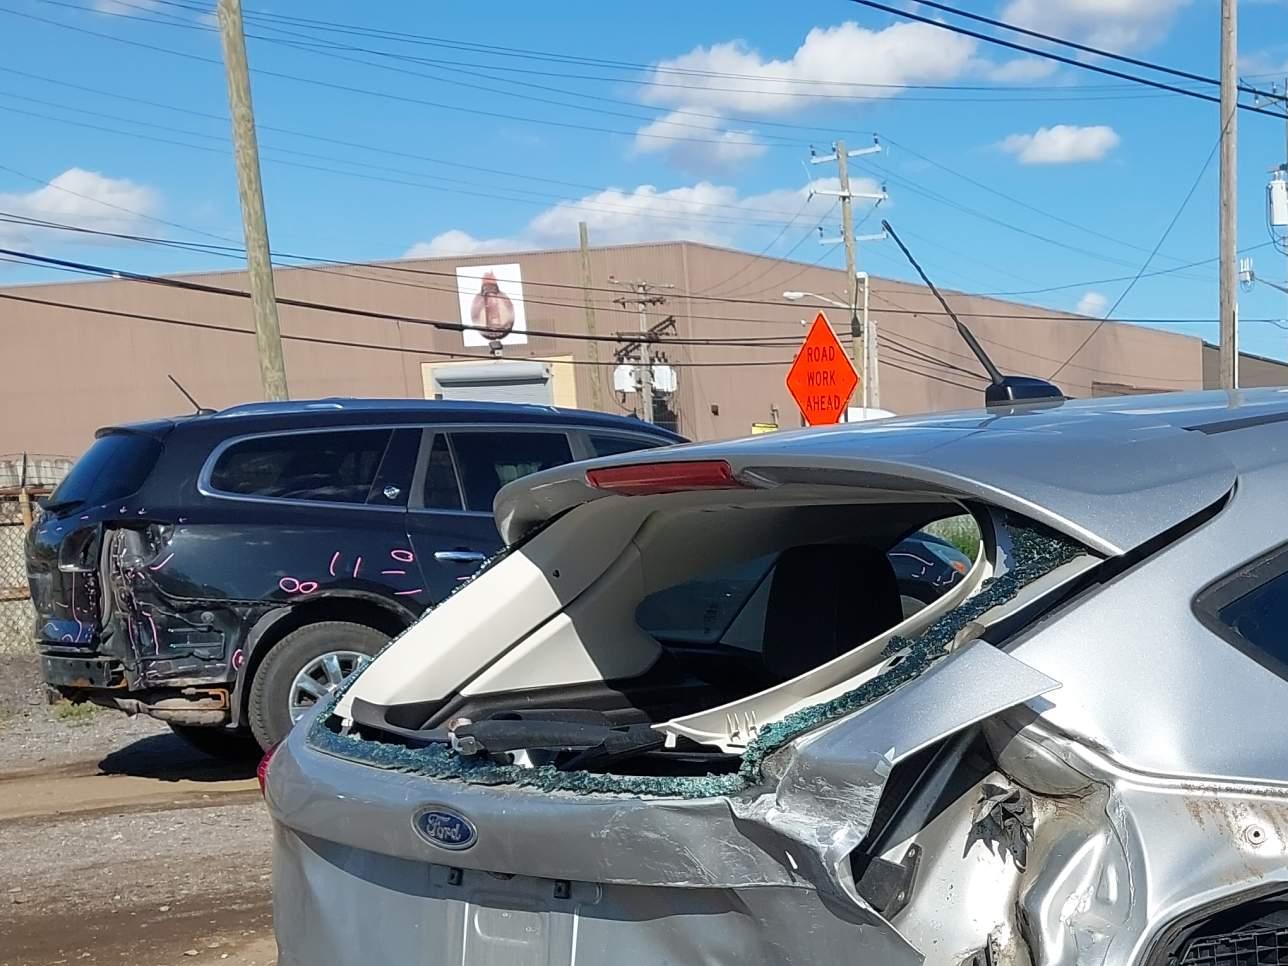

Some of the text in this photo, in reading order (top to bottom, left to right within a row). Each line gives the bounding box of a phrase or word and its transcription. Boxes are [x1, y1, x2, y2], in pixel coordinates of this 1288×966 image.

[806, 346, 835, 362] ROAD
[807, 371, 836, 386] WORK
[806, 395, 840, 411] AHEAD
[426, 814, 462, 840] Ford
